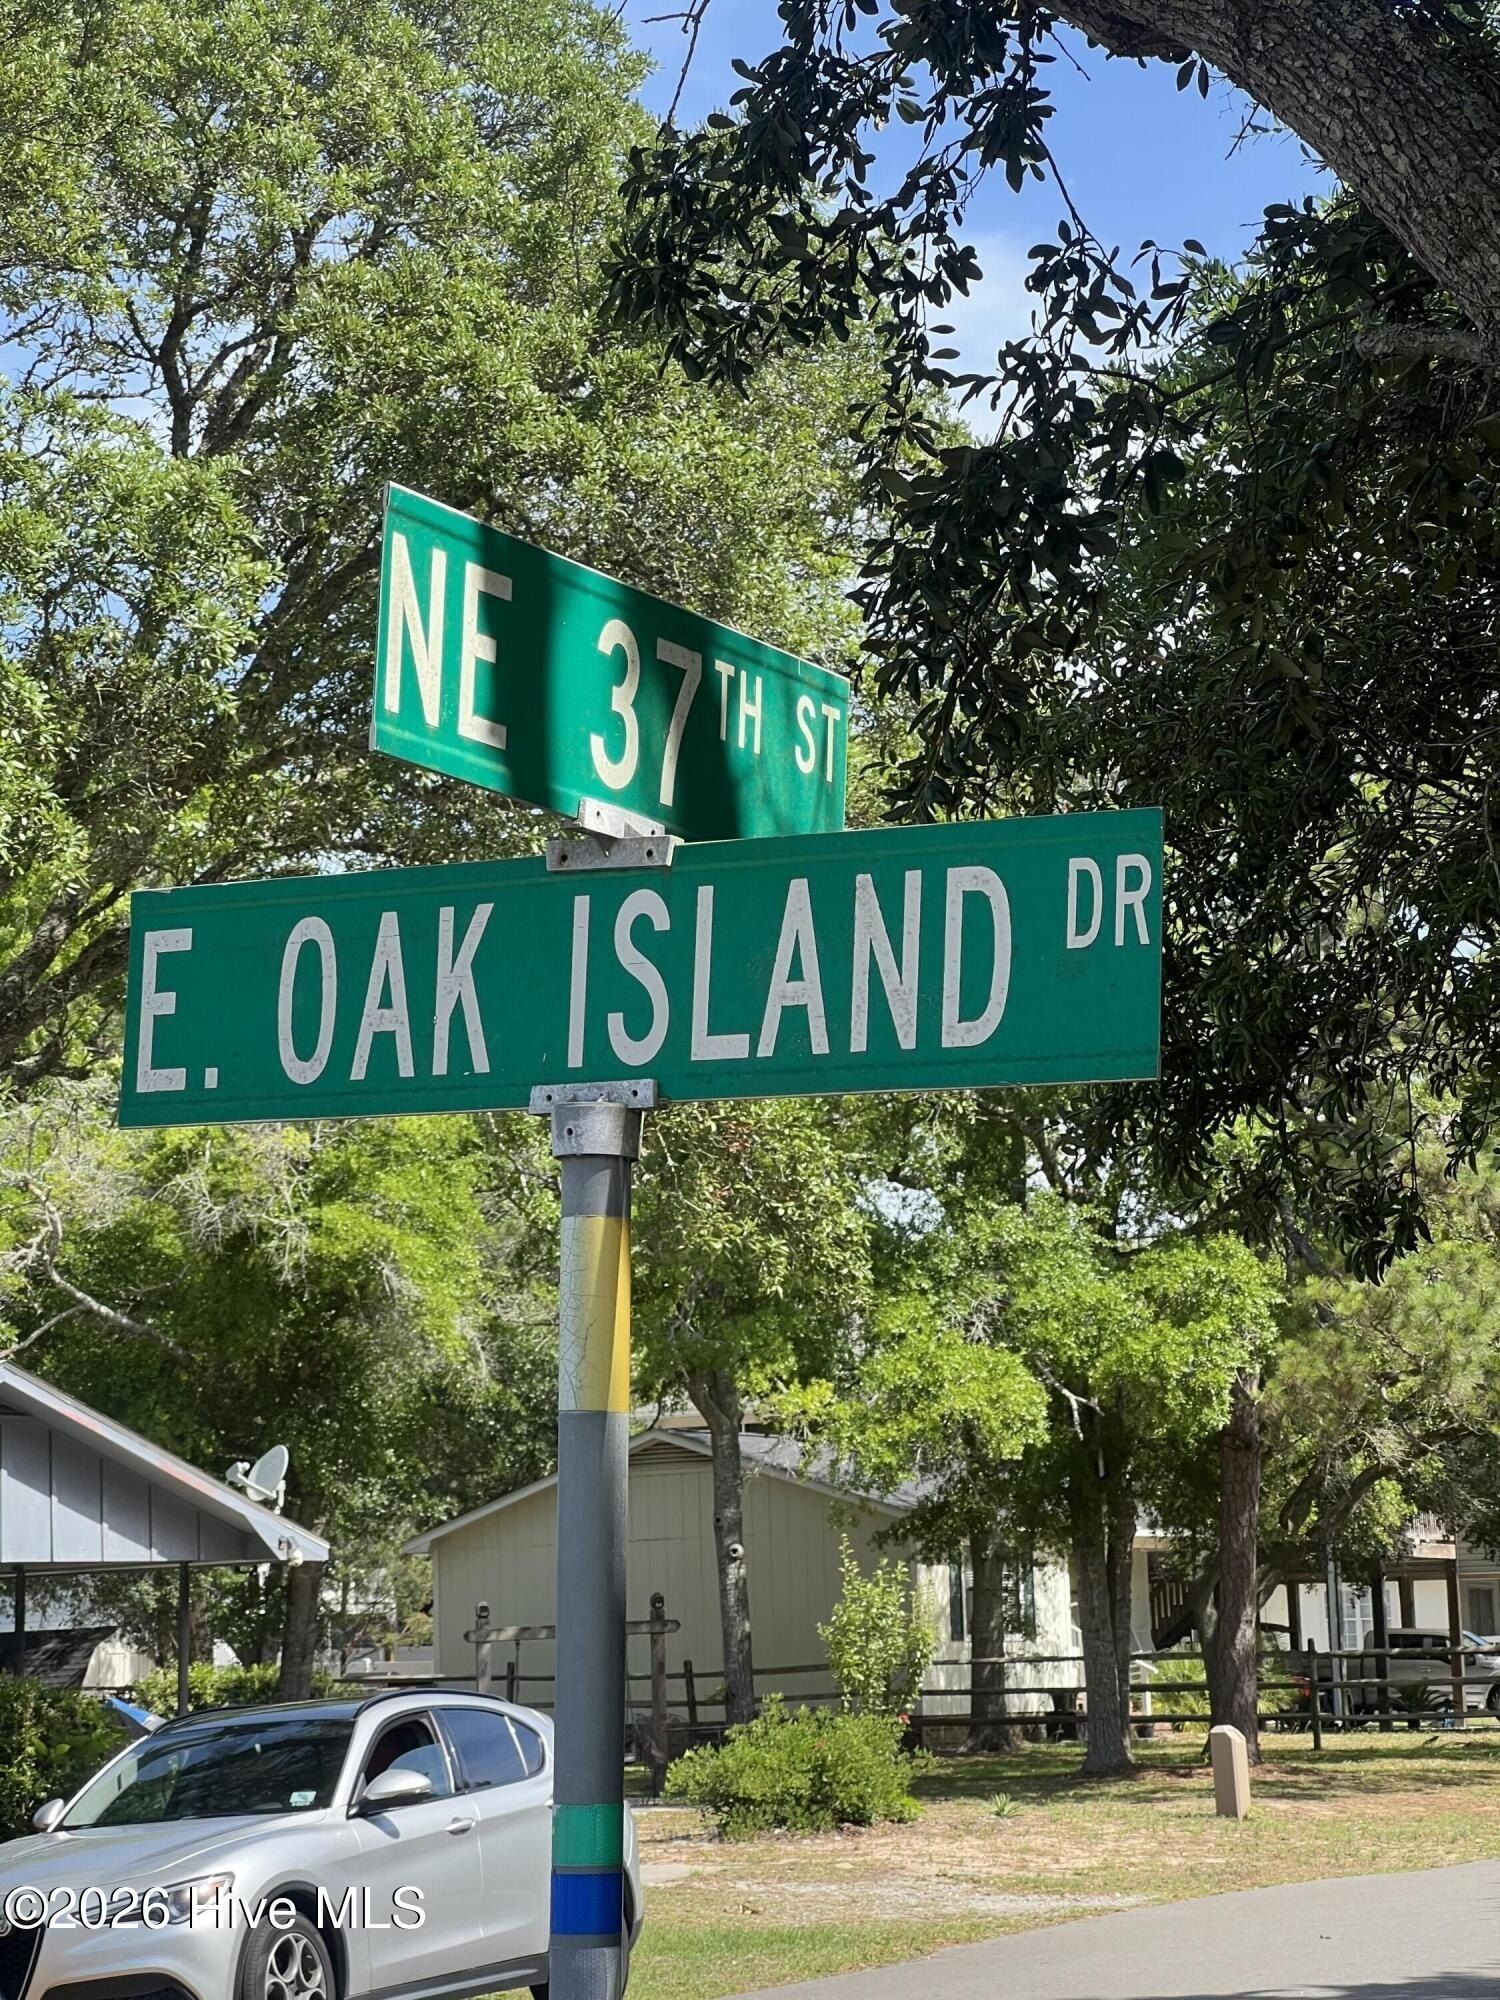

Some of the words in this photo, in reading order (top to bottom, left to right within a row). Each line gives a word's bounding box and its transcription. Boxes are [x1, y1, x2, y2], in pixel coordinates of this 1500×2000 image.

[384, 531, 513, 751] NE
[590, 619, 763, 808] 37TH
[795, 695, 842, 783] ST
[136, 927, 218, 1093] E.
[277, 902, 495, 1085] OAK
[567, 865, 1012, 1068] ISLAND
[1066, 853, 1153, 950] DR
